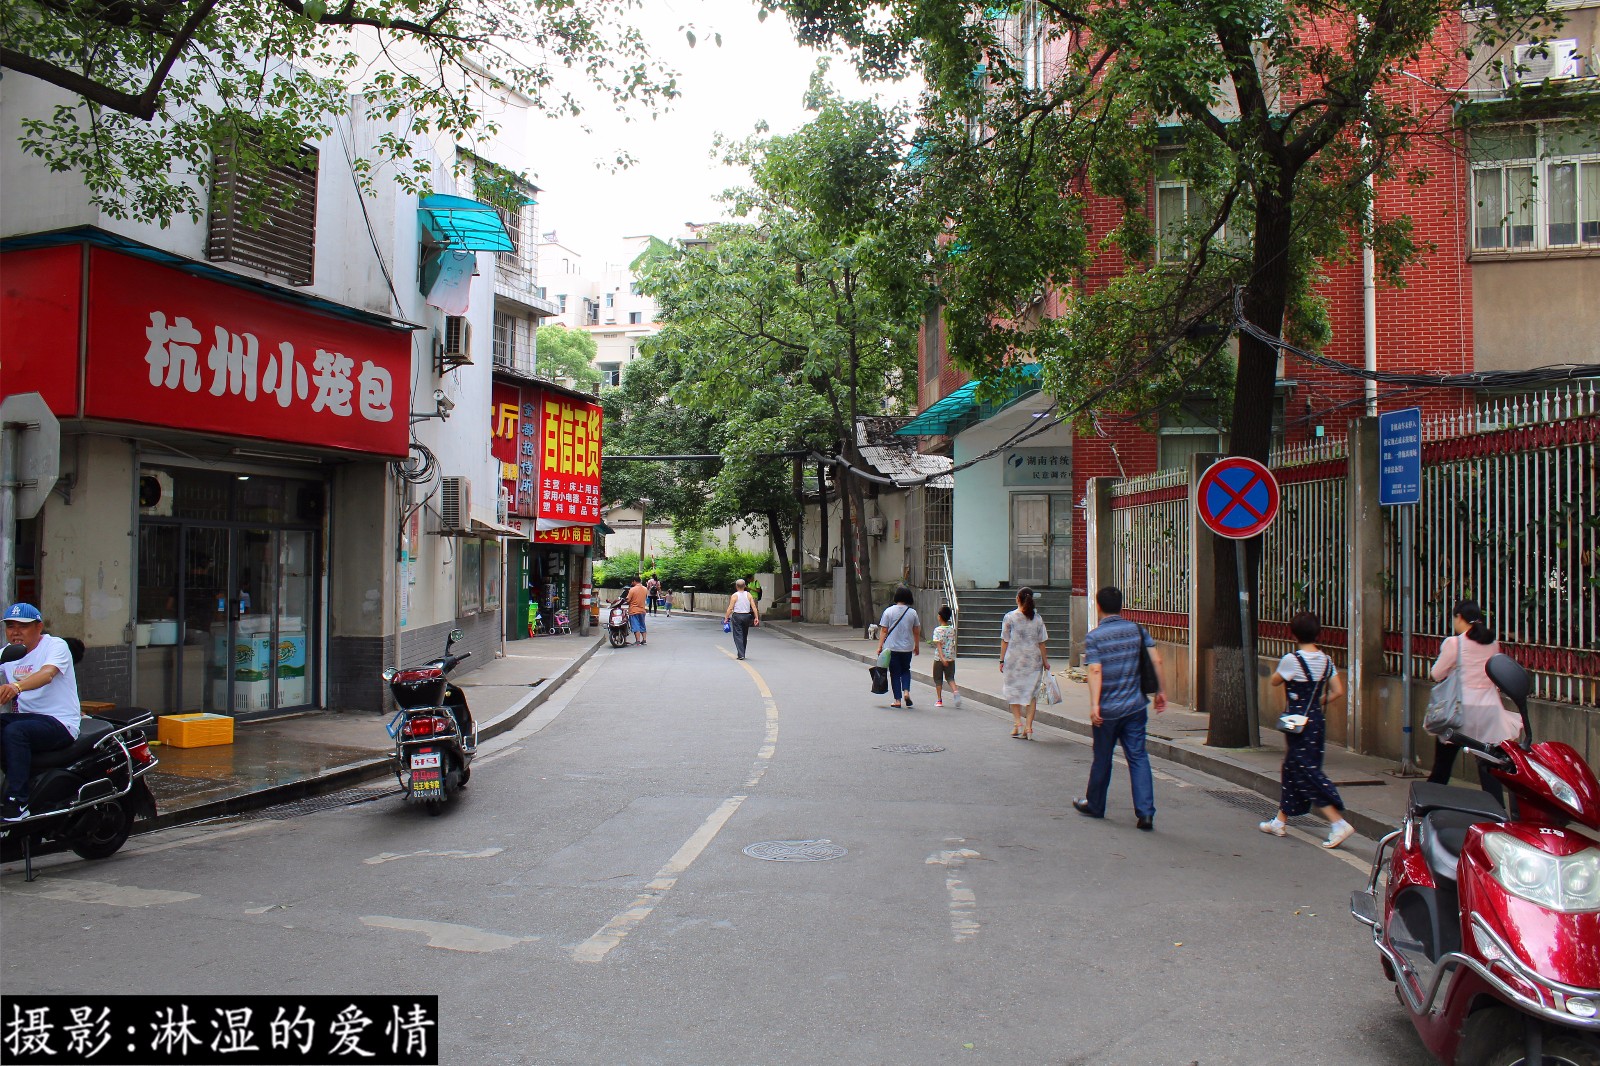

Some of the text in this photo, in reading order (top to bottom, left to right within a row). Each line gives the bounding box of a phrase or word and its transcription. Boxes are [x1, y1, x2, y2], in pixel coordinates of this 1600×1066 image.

[145, 311, 393, 422] 杭州小笼包
[491, 403, 518, 440] 厅
[545, 401, 600, 478] 百信百货
[520, 402, 535, 494] 金都招待所
[542, 501, 599, 517] 塑料制品等
[543, 489, 599, 506] 家用小电器、五金
[14, 664, 33, 676] NIKE
